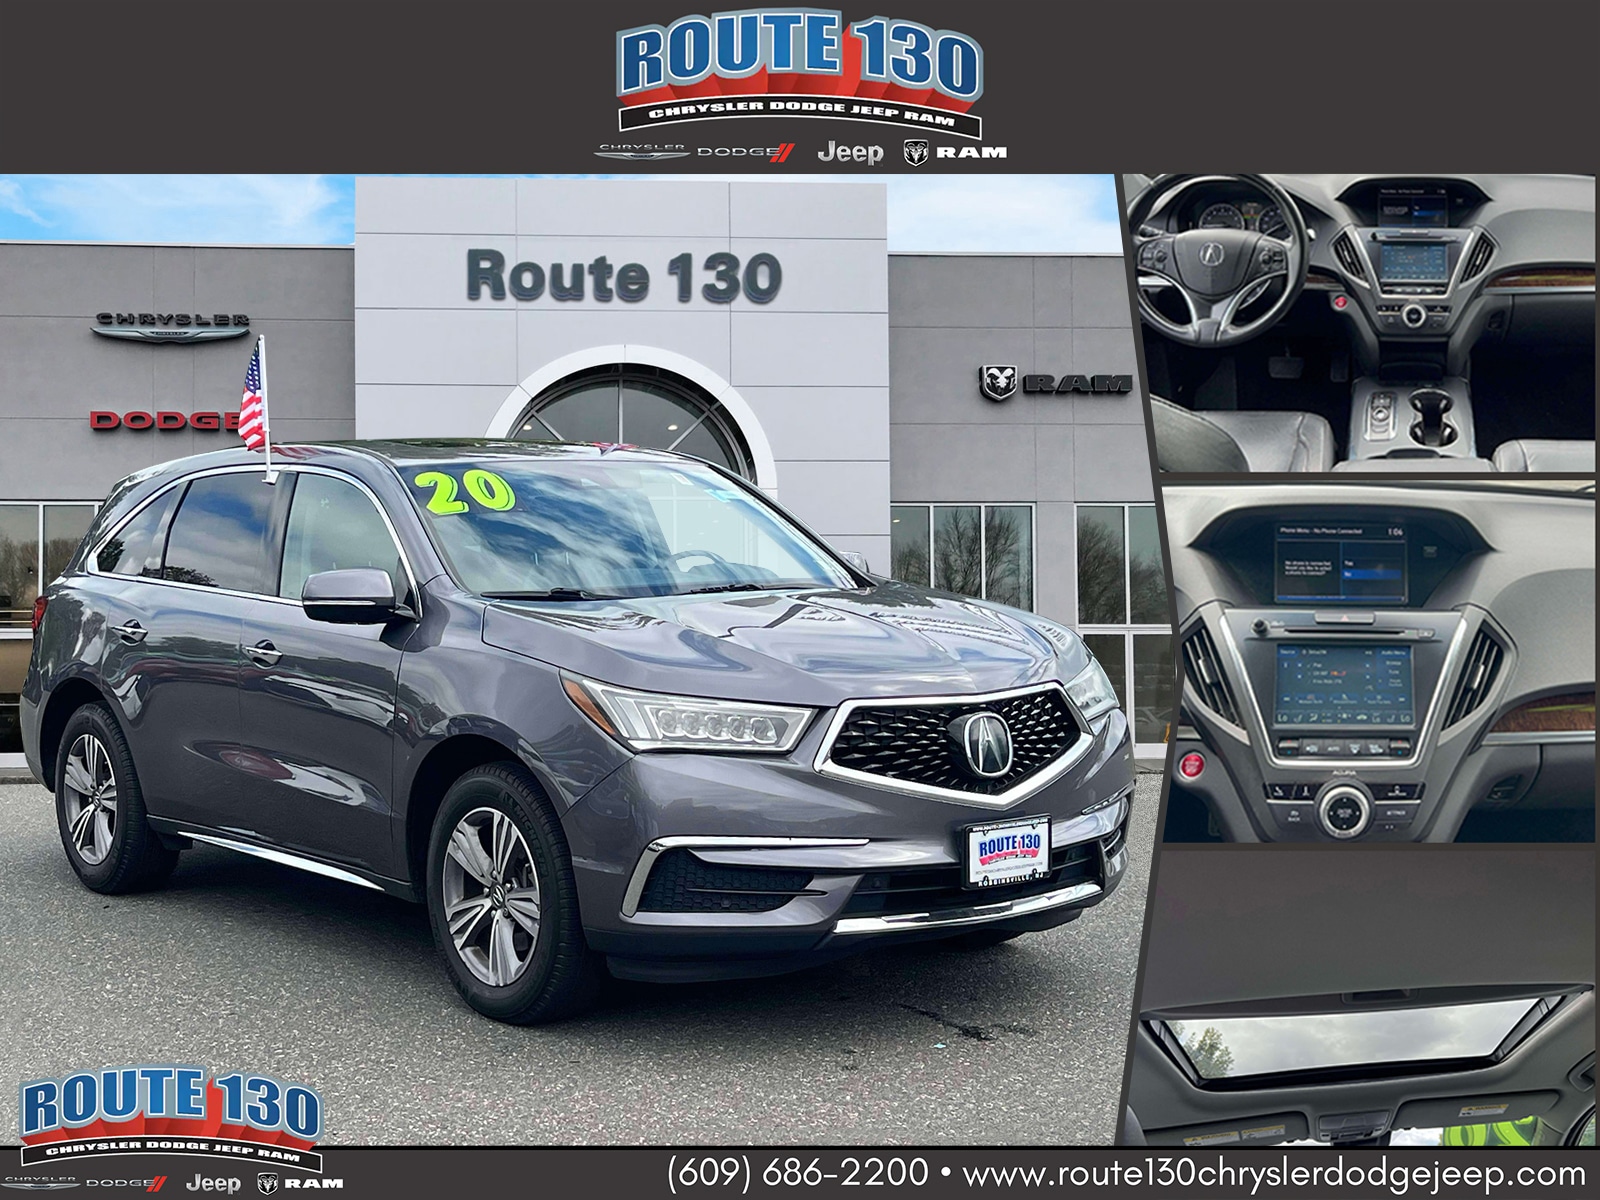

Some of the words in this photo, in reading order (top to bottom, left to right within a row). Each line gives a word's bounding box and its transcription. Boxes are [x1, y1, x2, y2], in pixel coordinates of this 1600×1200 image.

[467, 248, 650, 301] Route
[667, 251, 782, 304] 130
[97, 312, 250, 326] CHRYSLER
[1024, 374, 1133, 393] RAM
[414, 469, 516, 516] 20
[979, 835, 1018, 857] ROUTE
[1020, 834, 1041, 849] 130
